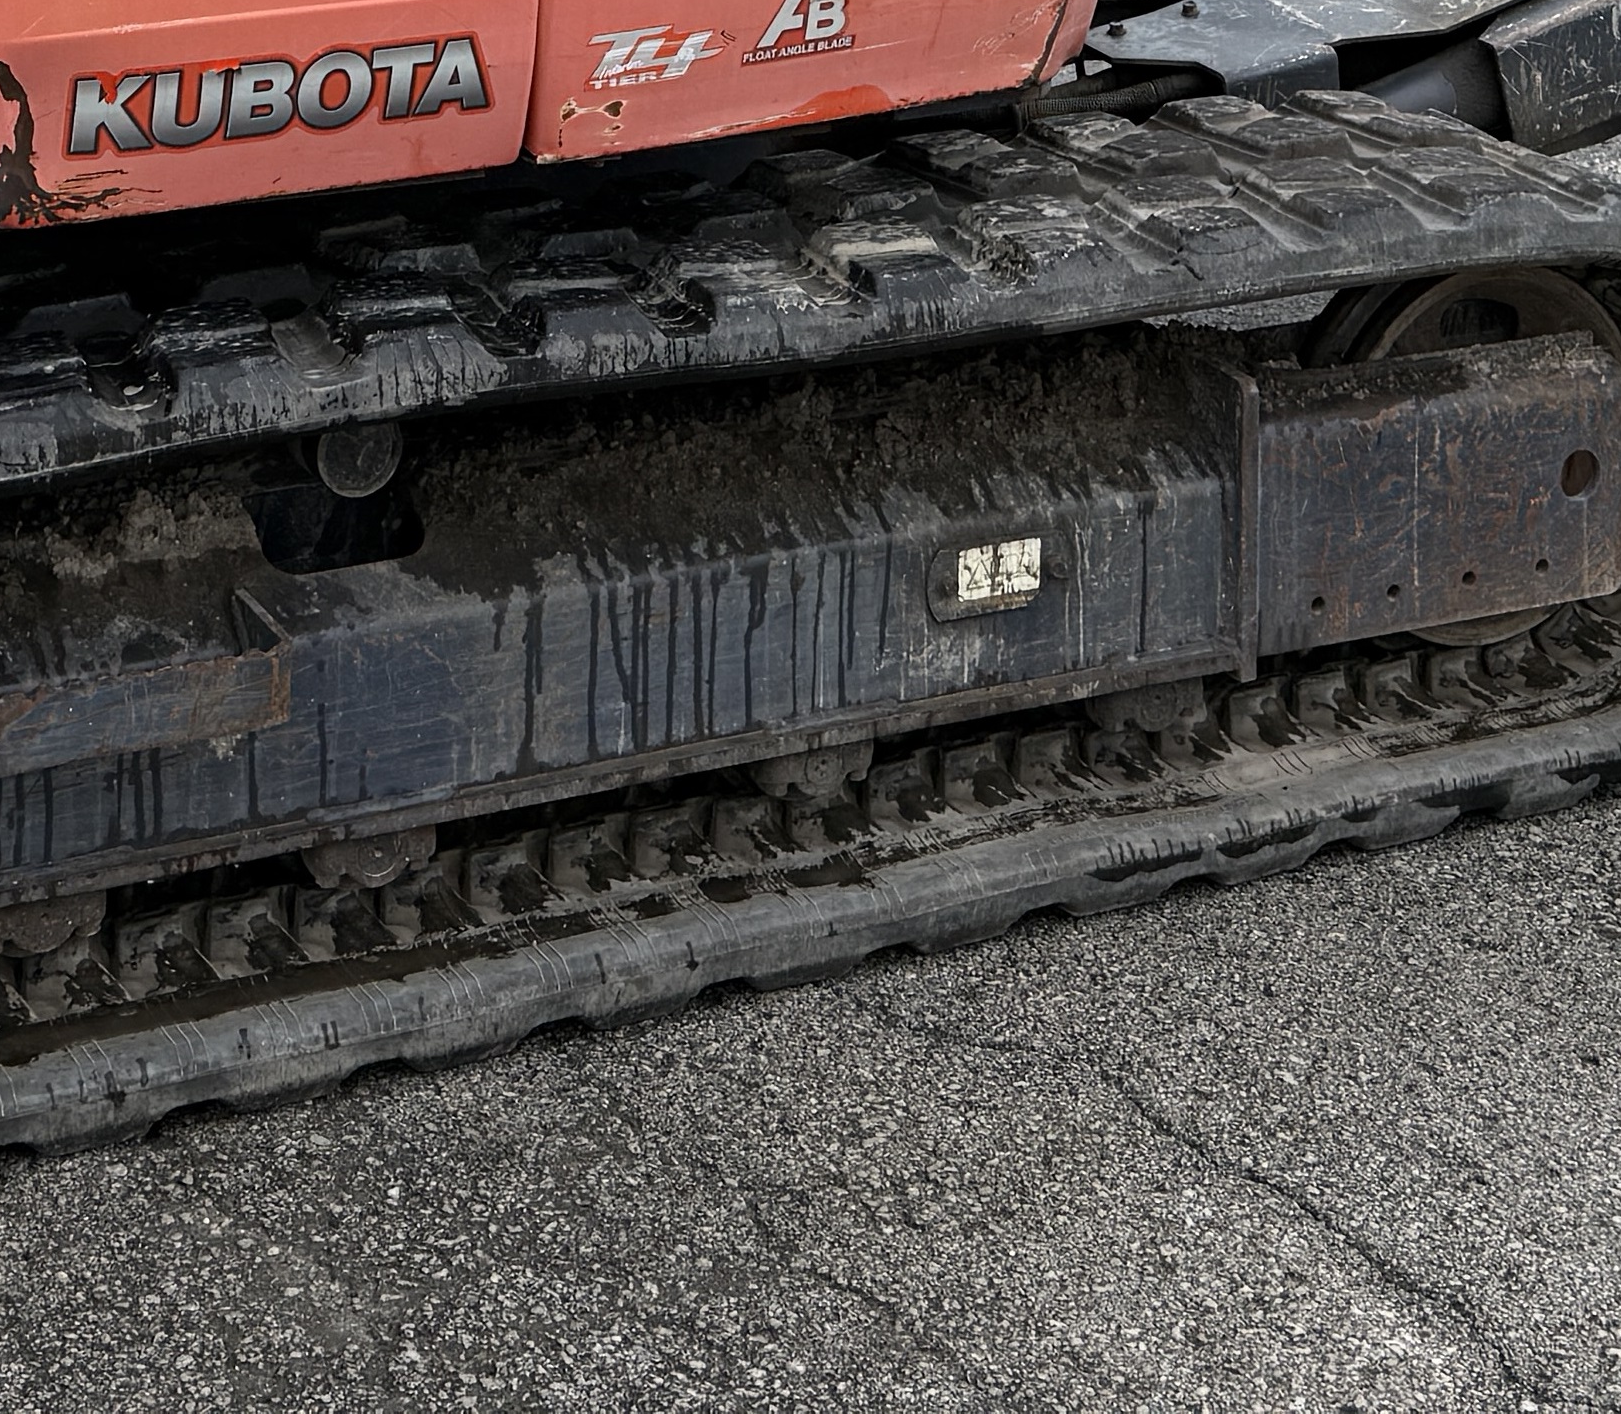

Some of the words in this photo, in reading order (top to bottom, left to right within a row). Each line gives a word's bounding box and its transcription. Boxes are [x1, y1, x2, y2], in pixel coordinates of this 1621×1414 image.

[742, 49, 777, 64] FLOAT
[777, 42, 815, 57] ANGLE
[817, 36, 853, 51] BLADE
[68, 37, 489, 155] KUBOTA
